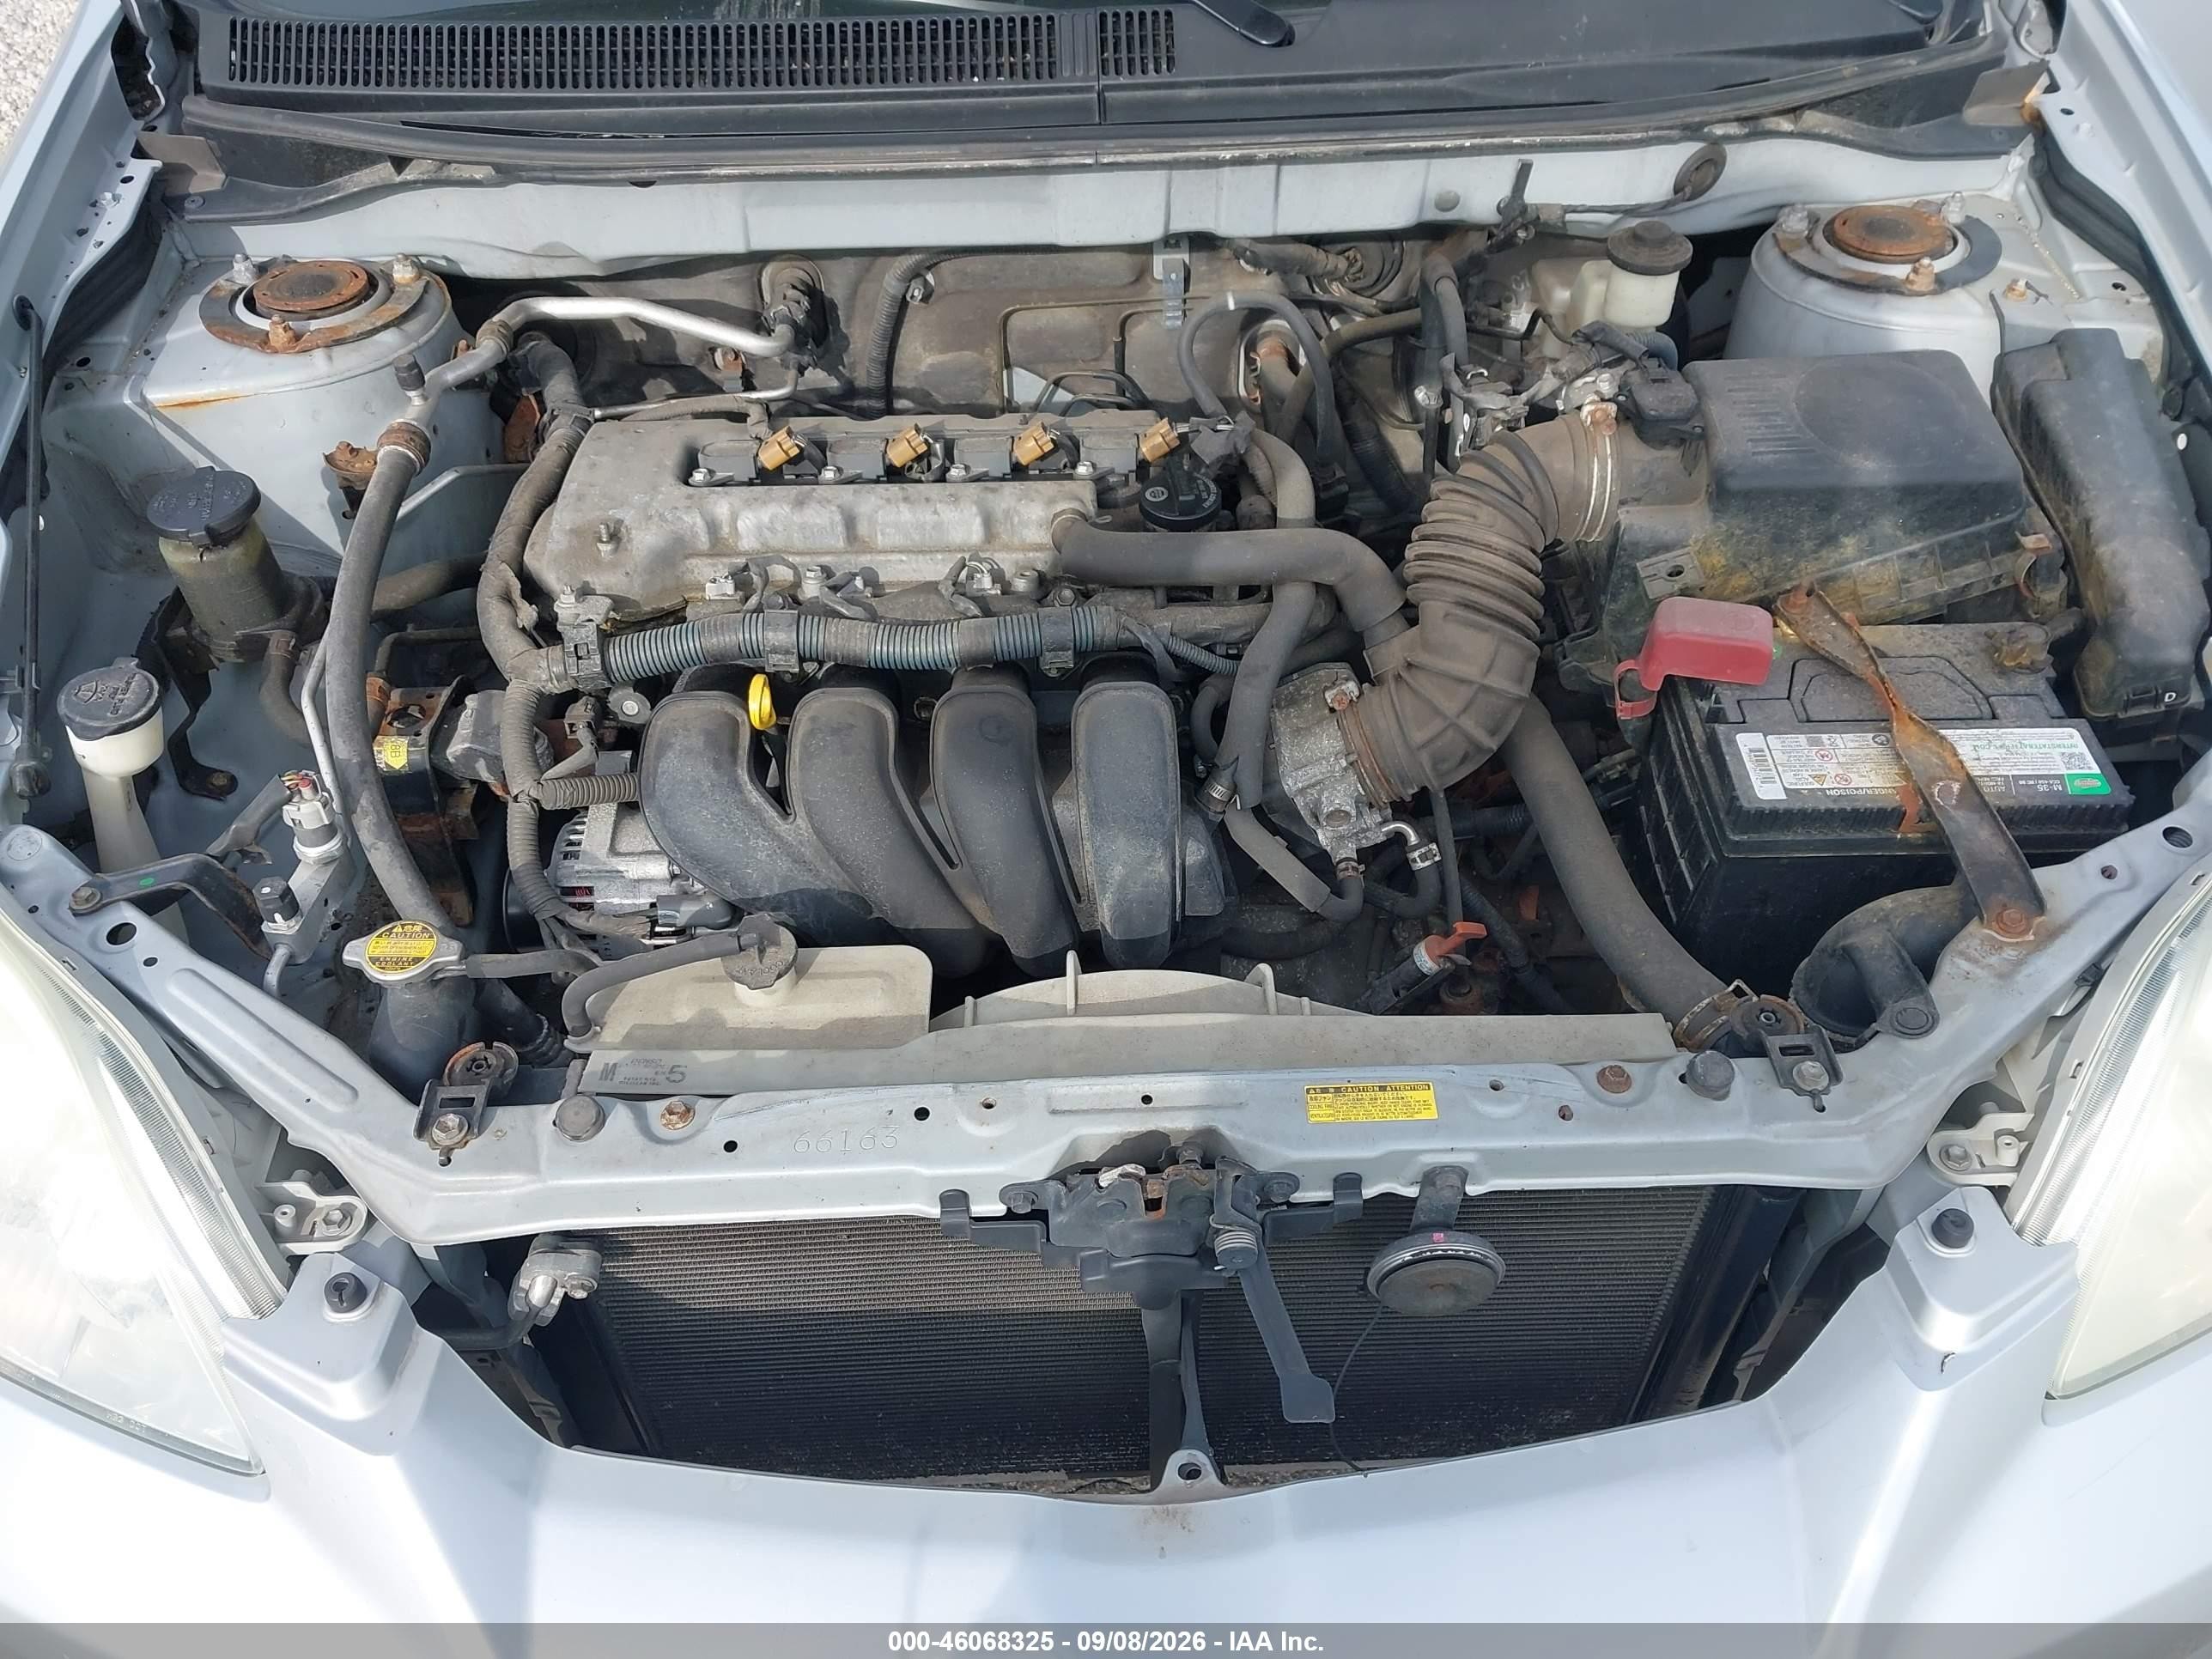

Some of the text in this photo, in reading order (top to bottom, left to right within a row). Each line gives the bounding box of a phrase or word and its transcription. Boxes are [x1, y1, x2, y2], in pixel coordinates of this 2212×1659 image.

[1826, 787, 1897, 796] NGER/POISON
[2036, 783, 2063, 792] M-35
[599, 1061, 619, 1082] M
[665, 1064, 688, 1084] 5
[793, 1125, 901, 1153] 66163
